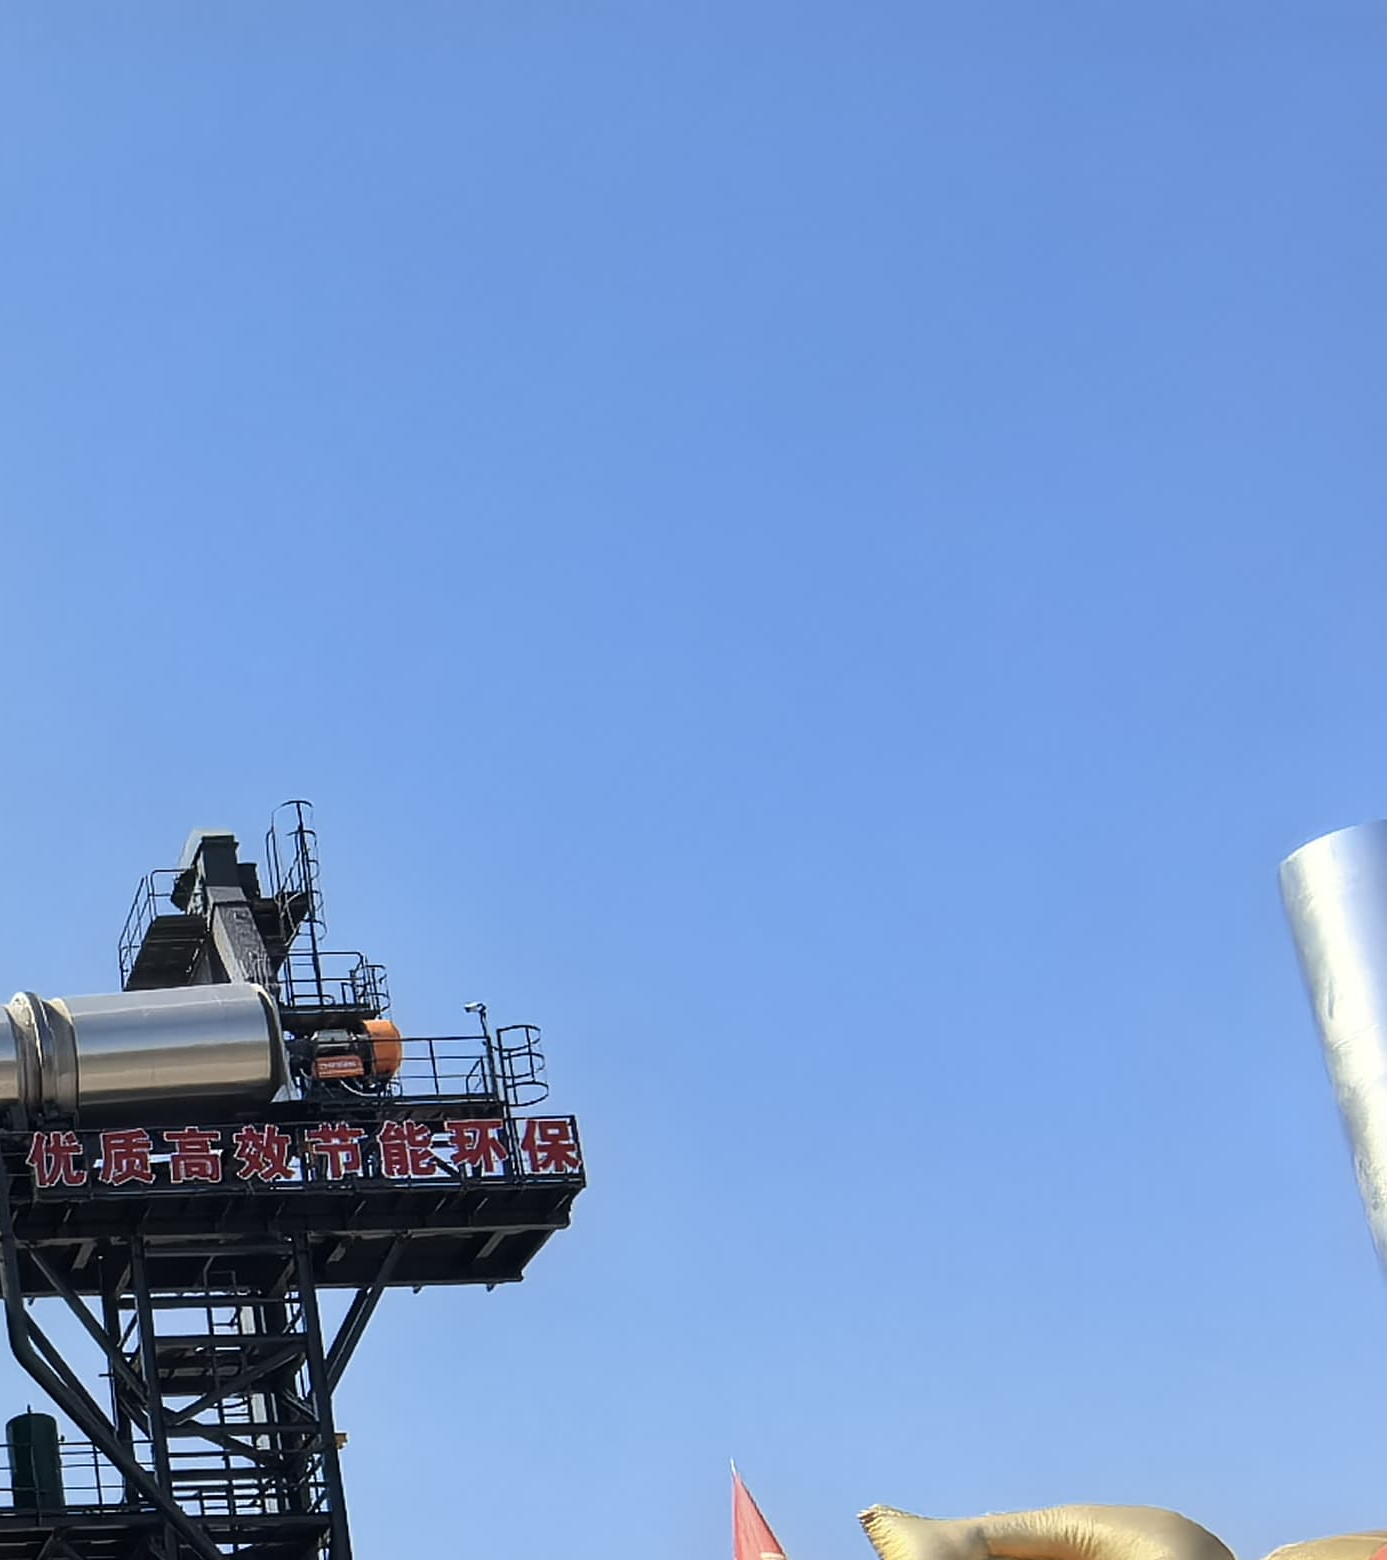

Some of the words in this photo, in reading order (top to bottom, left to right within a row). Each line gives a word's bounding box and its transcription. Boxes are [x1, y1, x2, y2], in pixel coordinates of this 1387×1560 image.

[27, 1117, 583, 1186] 优质高效节能环保
